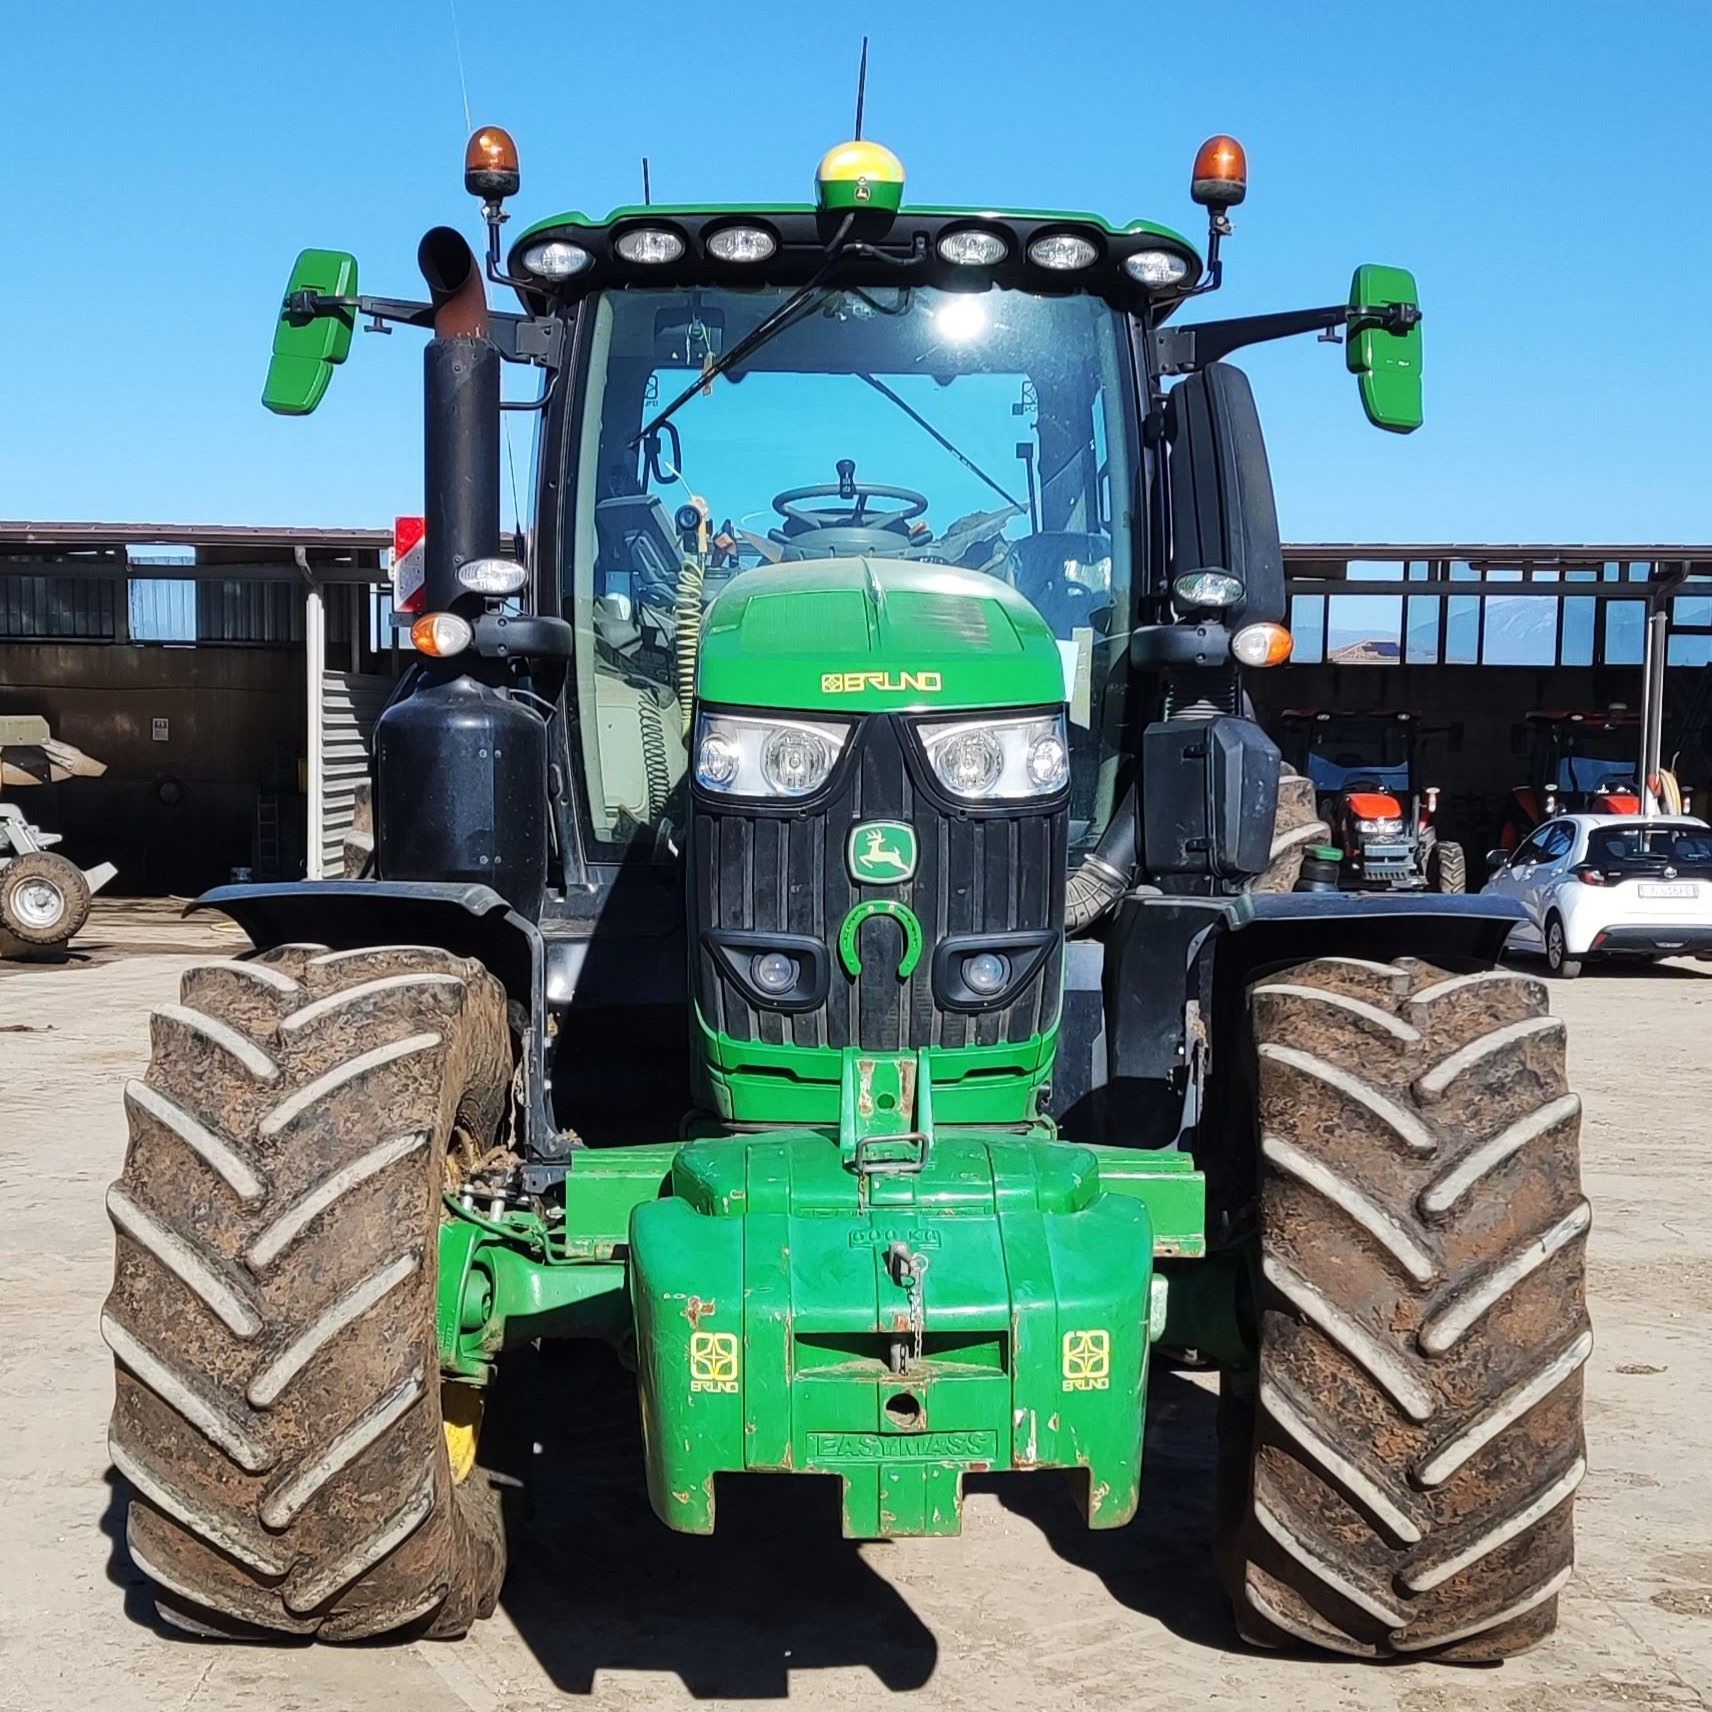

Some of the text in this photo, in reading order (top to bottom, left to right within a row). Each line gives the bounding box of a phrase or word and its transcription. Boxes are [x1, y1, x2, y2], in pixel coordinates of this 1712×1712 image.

[843, 671, 942, 692] BRUNO
[690, 1380, 739, 1393] BRUNO
[1062, 1377, 1110, 1392] BRUNO
